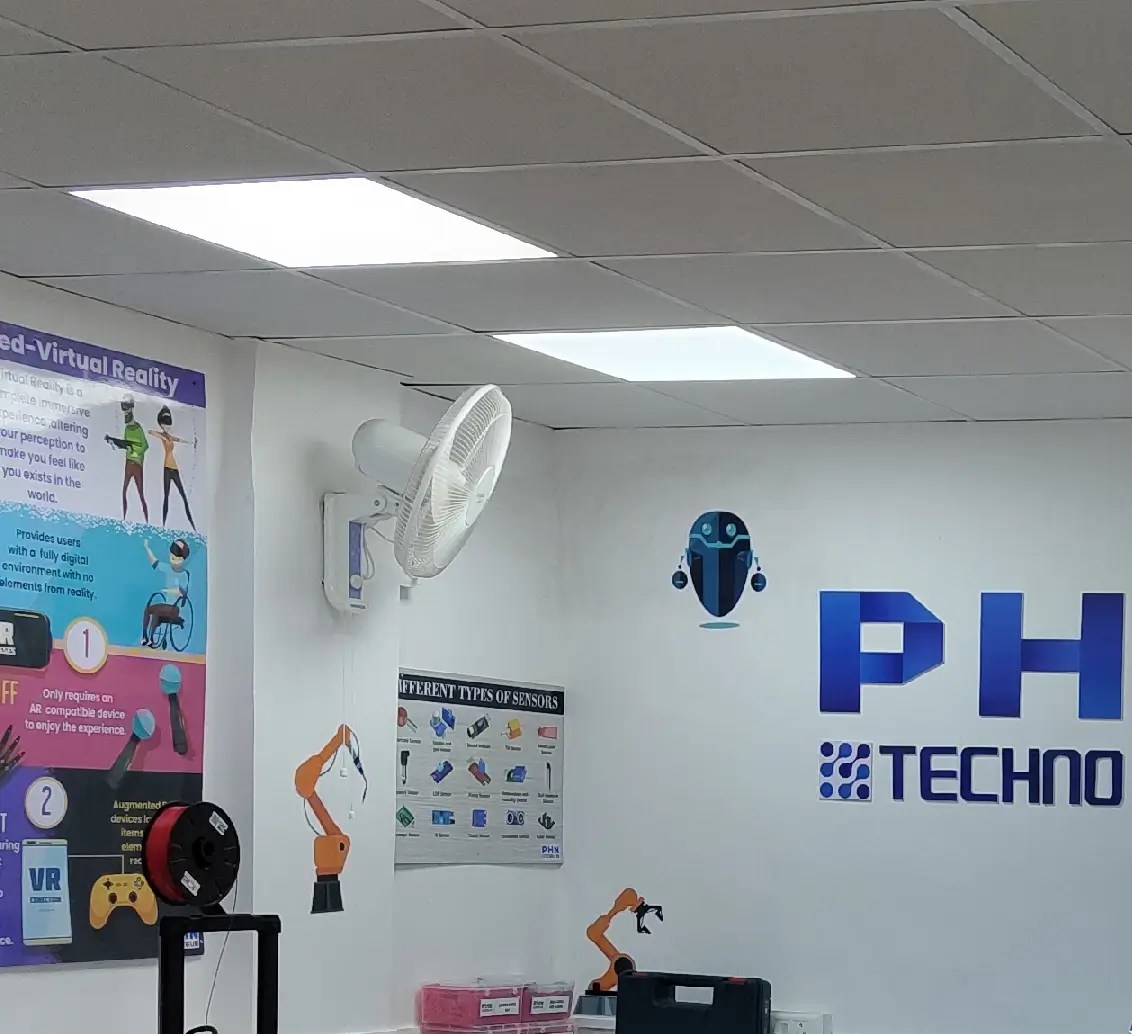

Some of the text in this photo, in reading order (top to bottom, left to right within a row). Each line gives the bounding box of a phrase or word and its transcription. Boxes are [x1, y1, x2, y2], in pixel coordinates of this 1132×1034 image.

[112, 359, 179, 397] Reality
[20, 431, 74, 451] perception
[76, 441, 86, 453] to
[27, 451, 46, 465] you
[48, 453, 67, 468] feel
[69, 457, 86, 472] like
[2, 466, 82, 489] you exists in the
[16, 528, 81, 548] Provides users
[8, 545, 89, 567] with a fully digital
[2, 562, 94, 583] environment with no
[44, 582, 65, 594] from
[67, 587, 98, 602] reality.
[83, 628, 89, 658] 1
[43, 688, 114, 704] Only requires an
[398, 678, 559, 710] IFFERENT TYPES OF SENSORS
[29, 703, 126, 720] AR compatible device
[25, 719, 35, 730] to
[35, 720, 61, 735] enjoy
[62, 721, 77, 732] the
[878, 744, 1124, 807] TECHNO
[41, 785, 52, 816] 2
[113, 800, 162, 812] Augmented
[110, 815, 143, 824] devices
[120, 842, 143, 852] elem
[28, 867, 62, 892] VR
